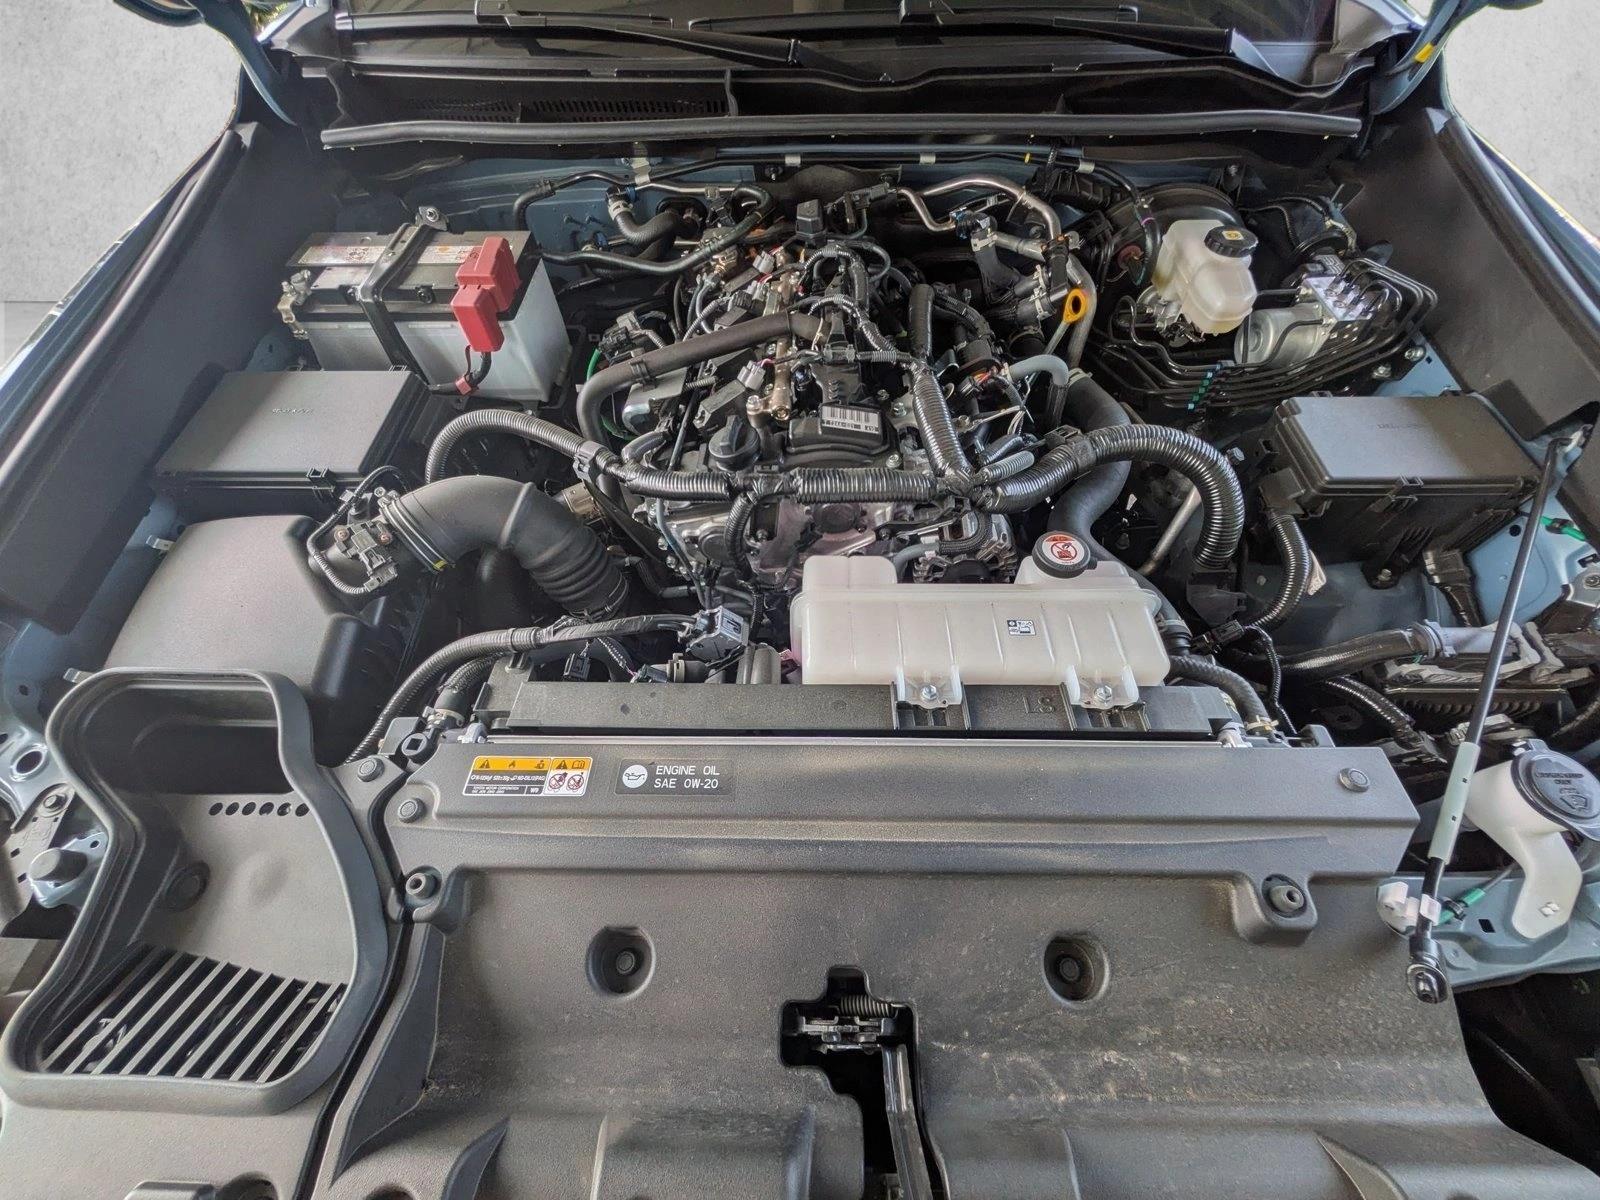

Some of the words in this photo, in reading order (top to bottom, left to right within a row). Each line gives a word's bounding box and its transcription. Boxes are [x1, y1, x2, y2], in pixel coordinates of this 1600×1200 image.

[655, 765, 697, 775] ENGINE
[702, 765, 720, 775] OIL
[653, 778, 677, 789] SAE
[683, 778, 719, 789] 0W-20
